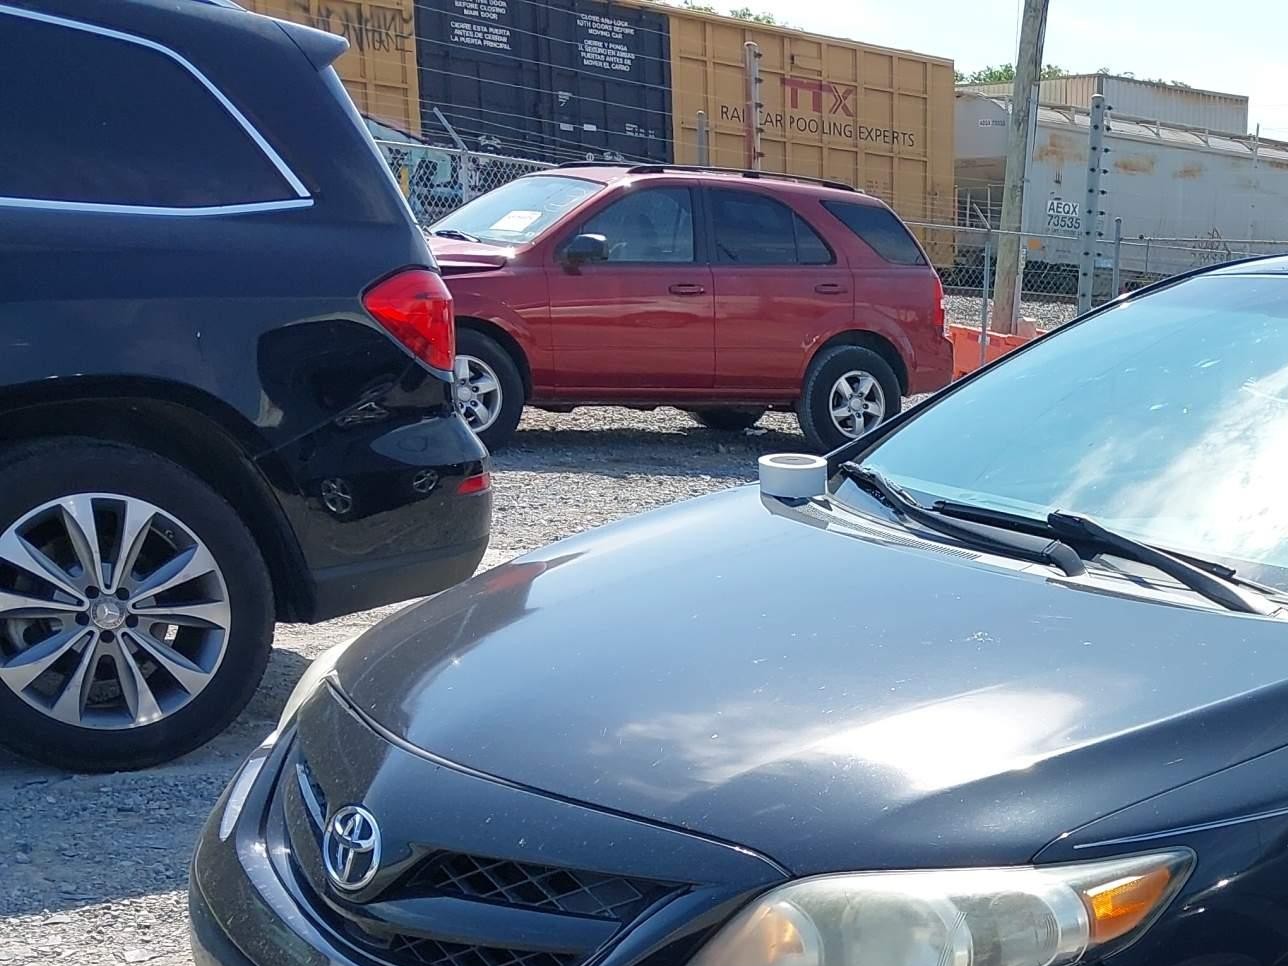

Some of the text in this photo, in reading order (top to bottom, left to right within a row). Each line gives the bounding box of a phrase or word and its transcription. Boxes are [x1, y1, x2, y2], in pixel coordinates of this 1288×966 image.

[780, 77, 855, 117] TTX
[789, 115, 853, 139] POOLING
[858, 125, 915, 147] EXPERTS
[1048, 201, 1078, 216] AEQX
[1047, 213, 1081, 229] 73535
